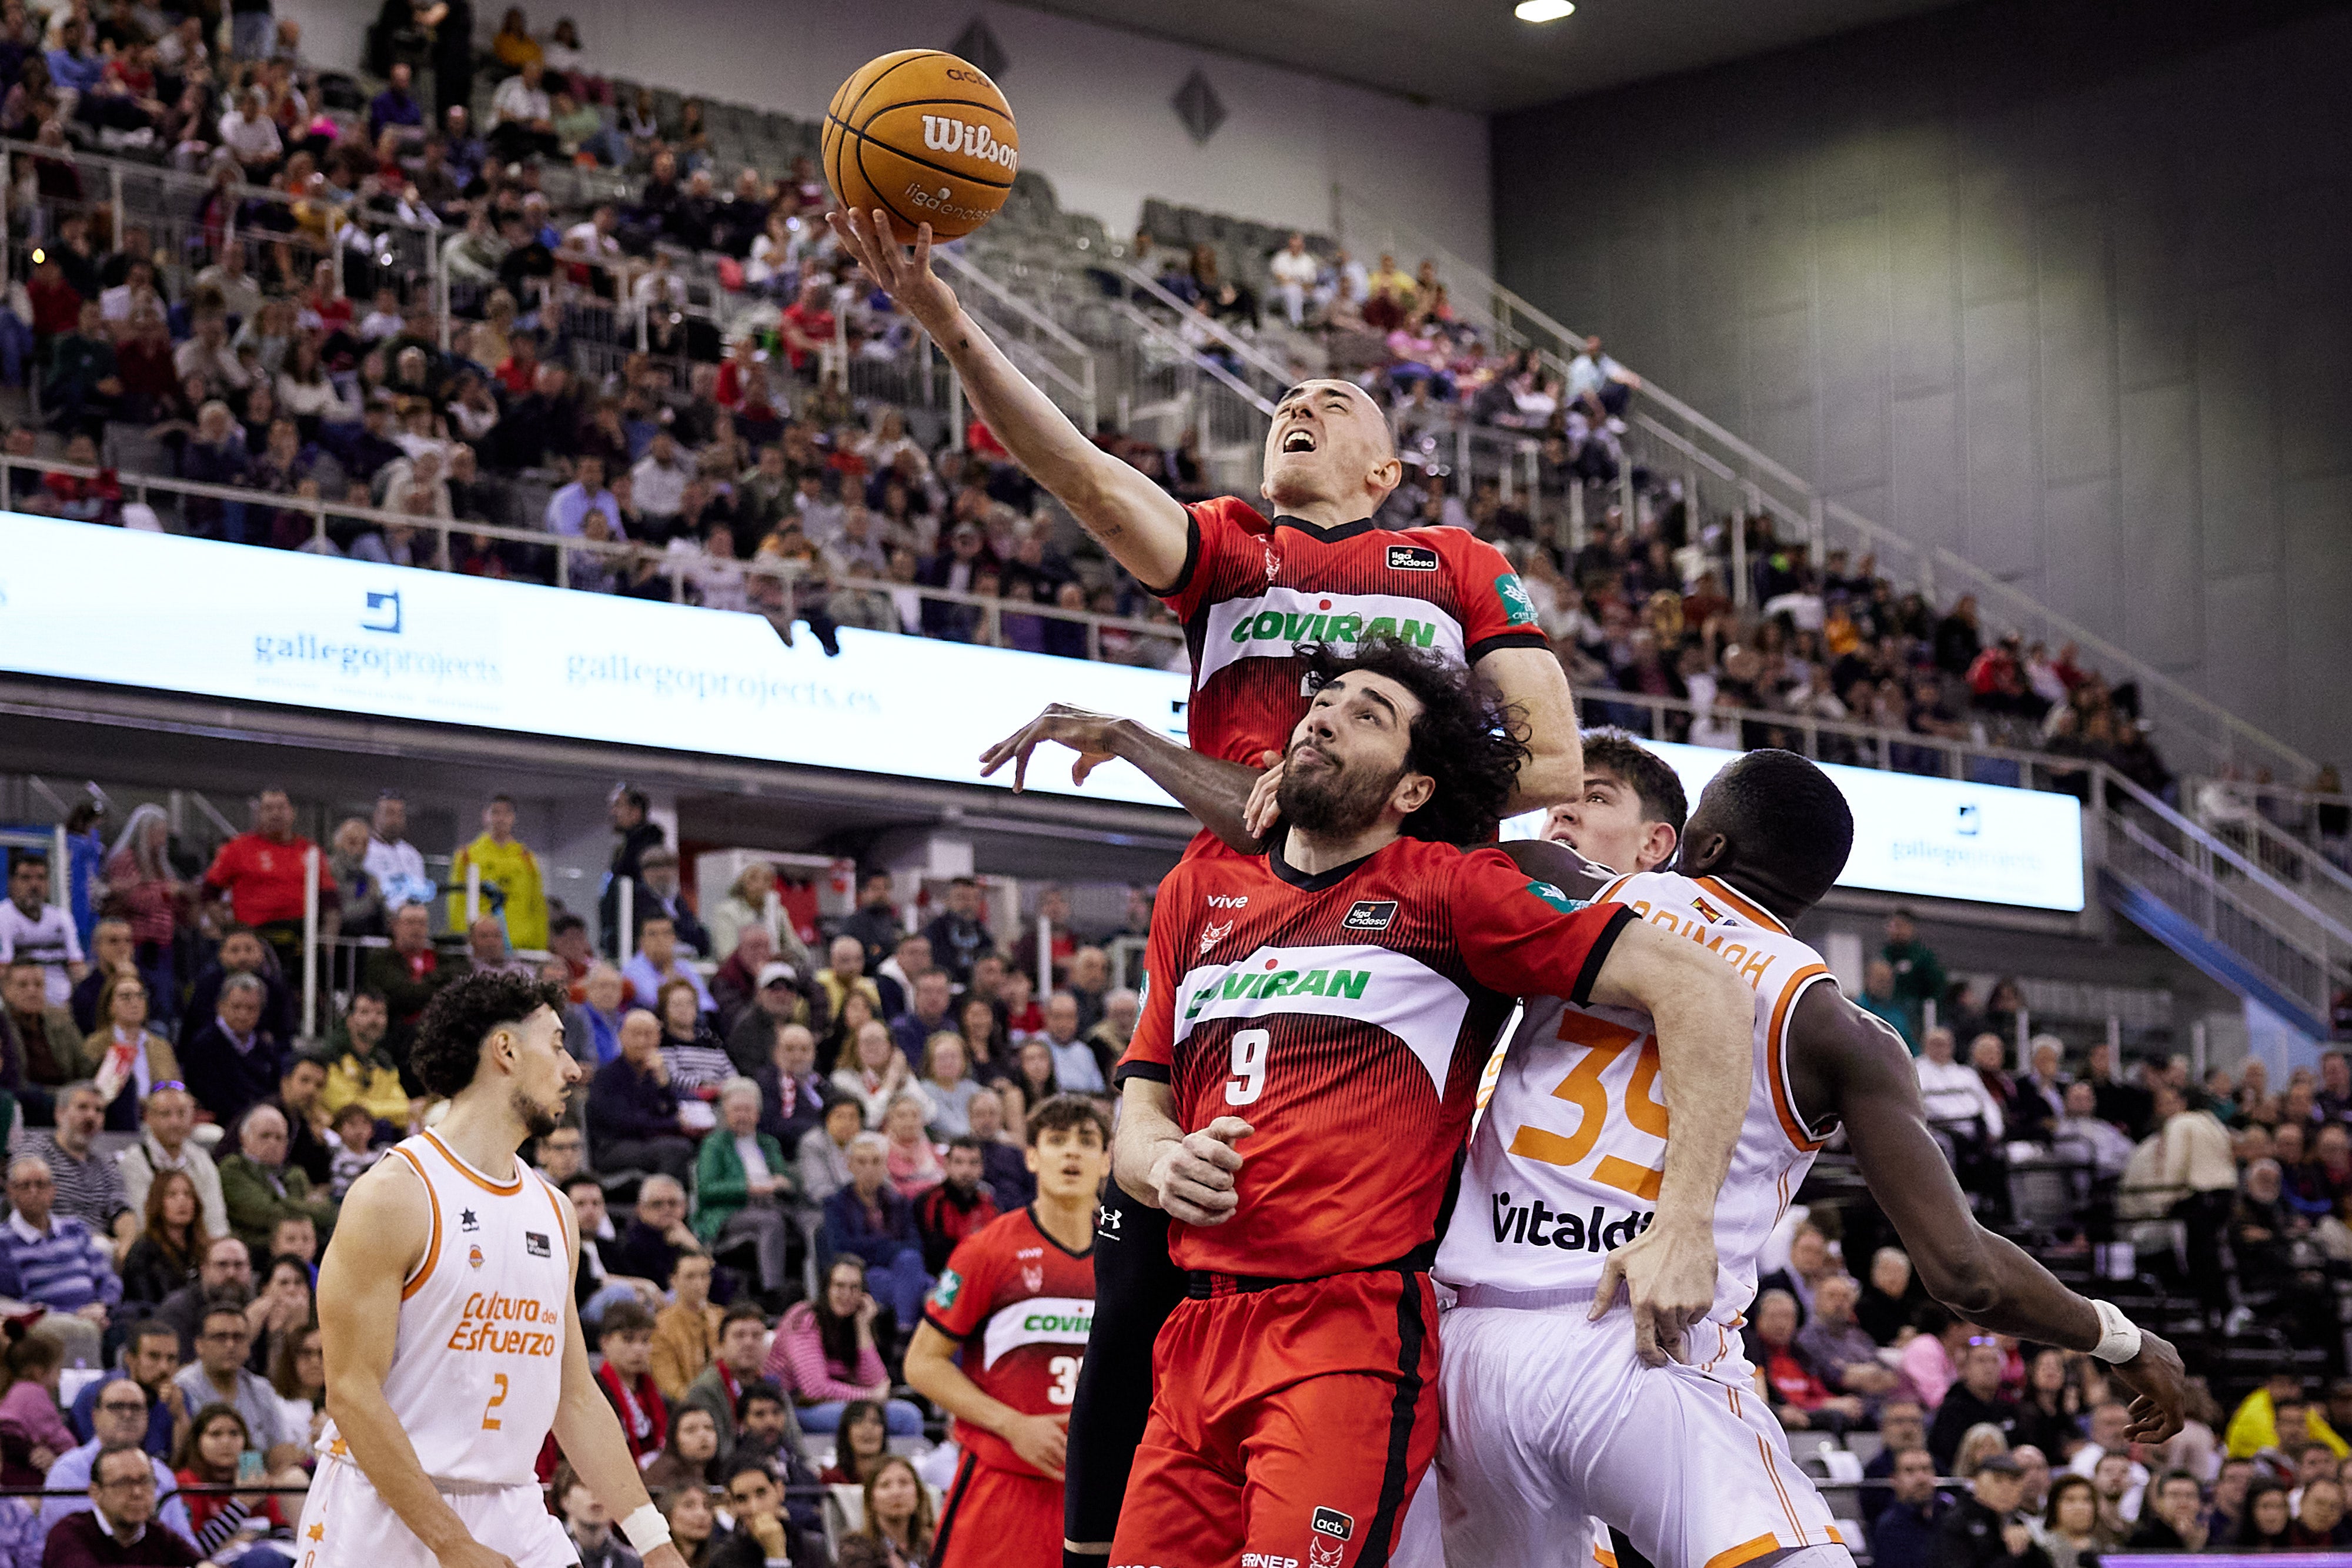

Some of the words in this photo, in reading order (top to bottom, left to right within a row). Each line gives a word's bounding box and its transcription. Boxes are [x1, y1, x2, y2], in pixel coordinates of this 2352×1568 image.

[921, 114, 1018, 172] Wilson
[1391, 551, 1412, 560] liga
[1231, 610, 1436, 648] COVIRAN
[1207, 894, 1248, 908] vive
[1352, 909, 1371, 918] liga
[1349, 917, 1387, 925] endesa
[1225, 1028, 1269, 1106] 9
[463, 1290, 541, 1322] Cultura
[542, 1309, 557, 1325] del
[447, 1320, 555, 1357] Esfuerzo
[1047, 1355, 1084, 1406] 3
[482, 1373, 509, 1430] 2
[1317, 1518, 1344, 1534] acb
